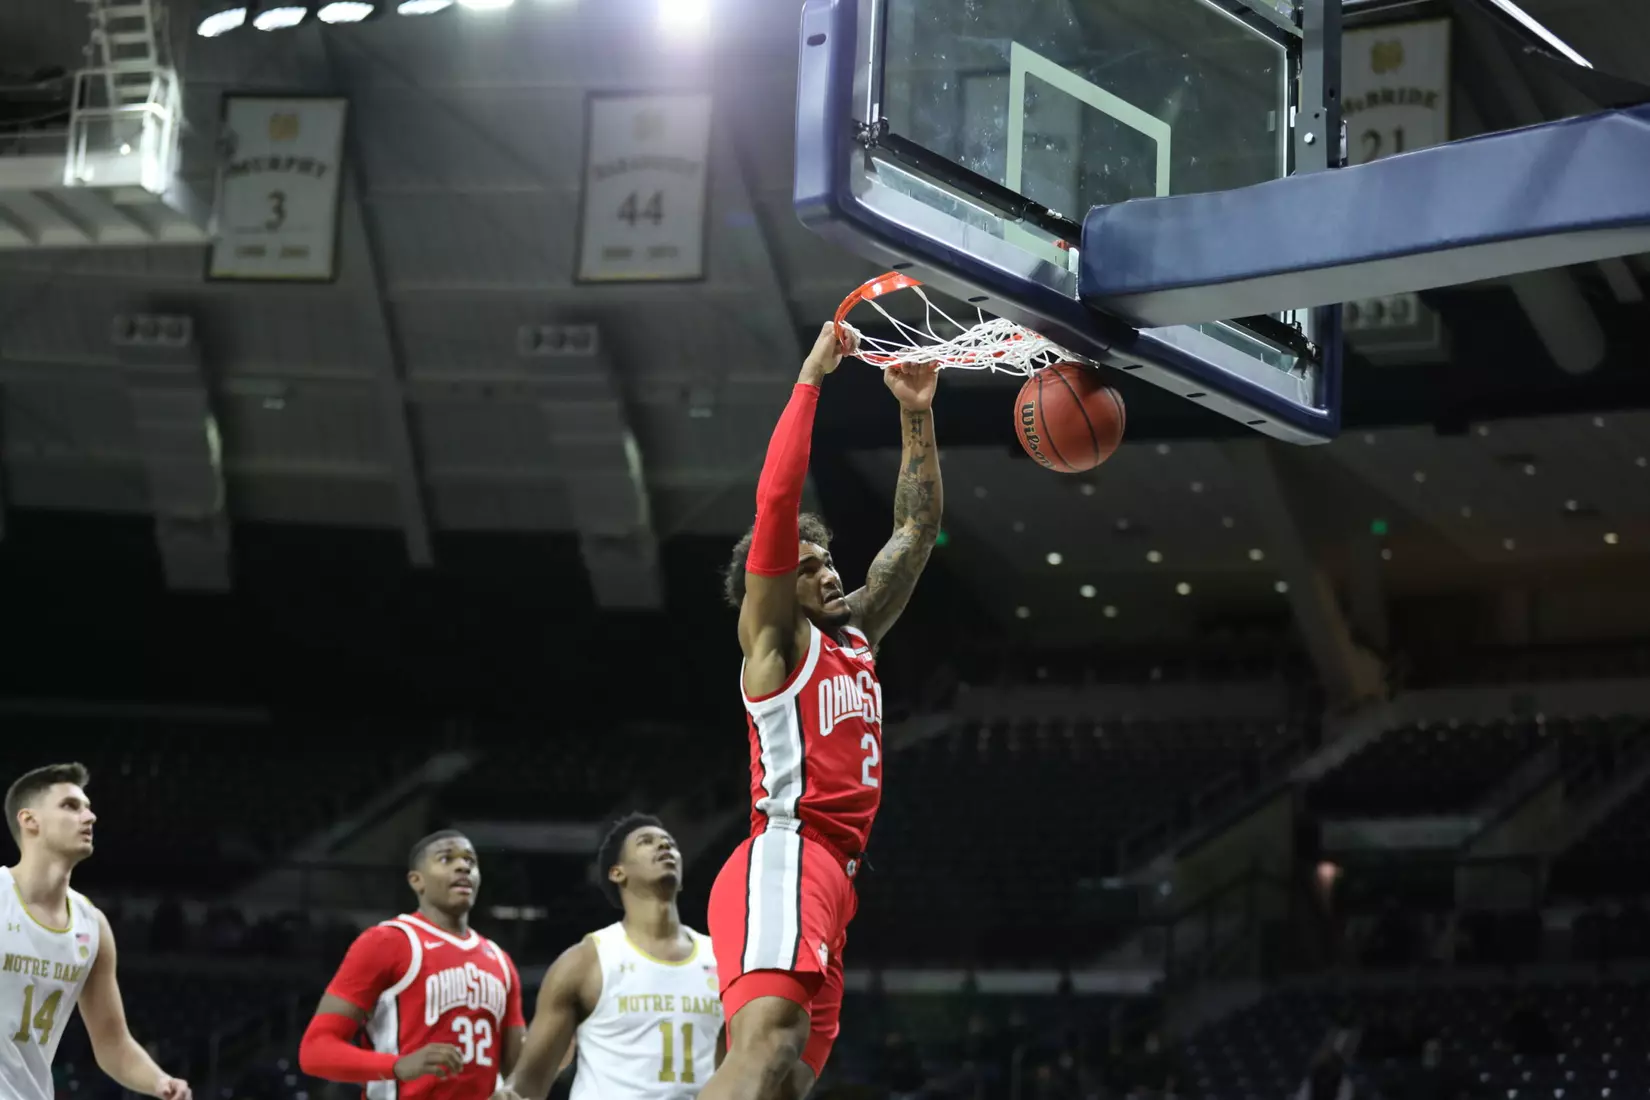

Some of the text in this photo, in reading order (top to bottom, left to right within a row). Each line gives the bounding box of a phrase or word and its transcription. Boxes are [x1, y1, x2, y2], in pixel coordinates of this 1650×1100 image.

[1361, 126, 1405, 162] 21
[264, 188, 287, 234] 3
[616, 189, 666, 229] 44
[861, 732, 879, 788] 2
[3, 953, 83, 982] NOTRE DAM
[13, 984, 64, 1045] 14
[618, 995, 675, 1013] NOTRE
[451, 1015, 493, 1067] 32
[658, 1021, 695, 1083] 11
